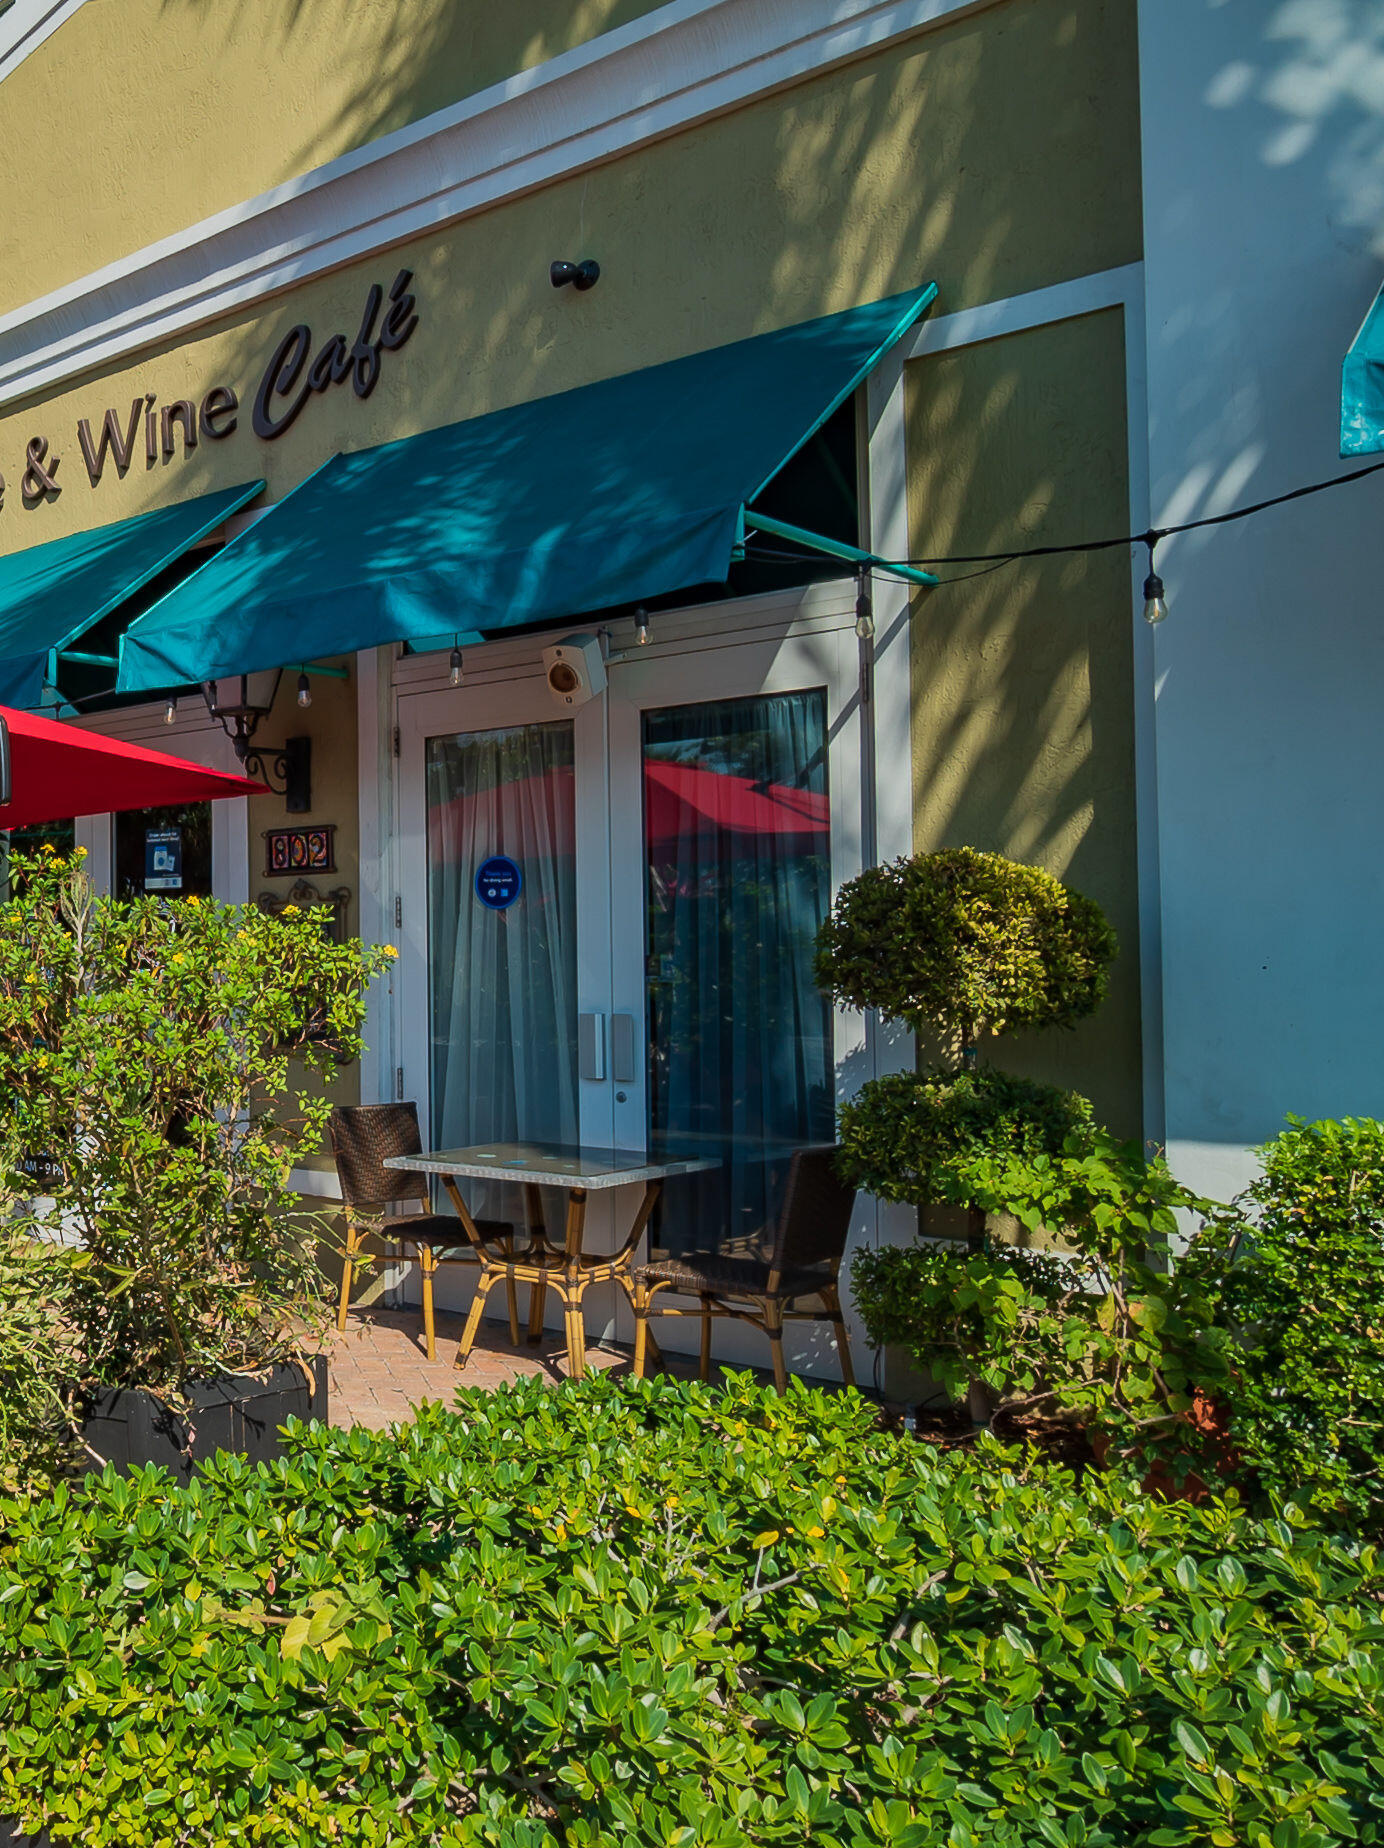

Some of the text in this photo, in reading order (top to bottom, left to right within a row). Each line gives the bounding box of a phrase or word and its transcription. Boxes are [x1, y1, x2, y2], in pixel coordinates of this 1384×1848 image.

[21, 435, 62, 500] &
[77, 386, 239, 479] Wine
[252, 268, 420, 440] Café
[272, 832, 327, 868] 802
[45, 1162, 51, 1174] 9
